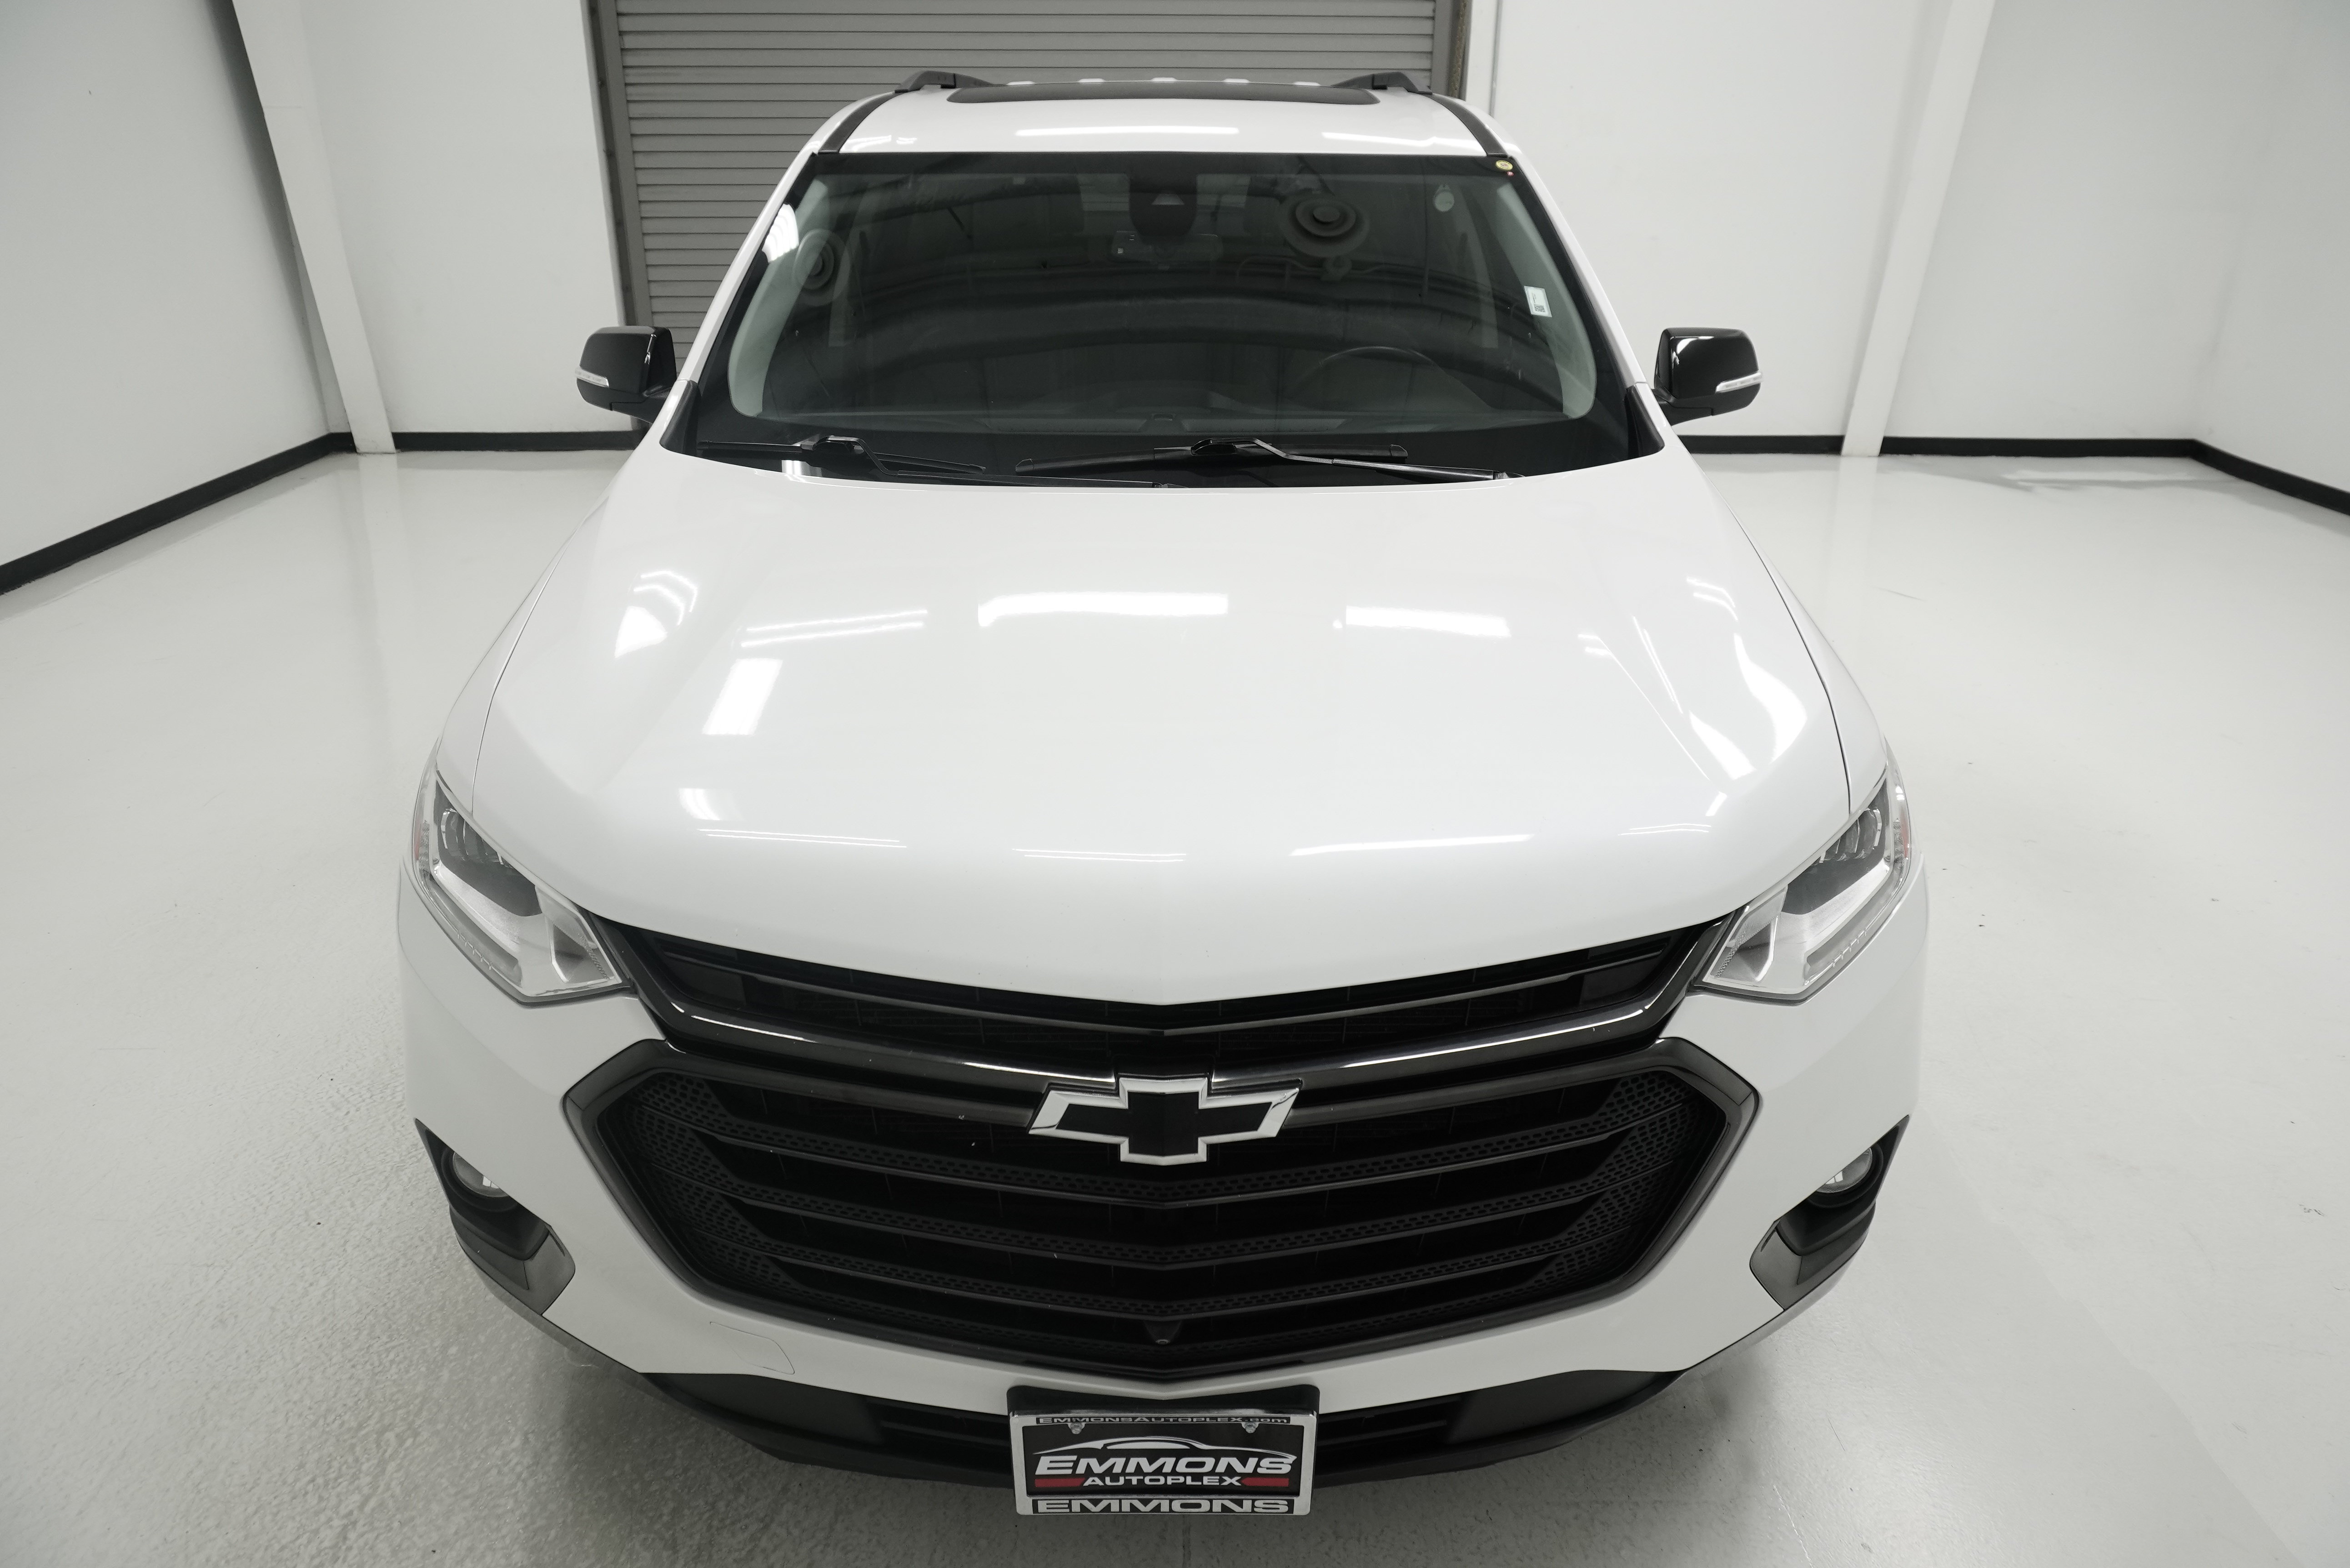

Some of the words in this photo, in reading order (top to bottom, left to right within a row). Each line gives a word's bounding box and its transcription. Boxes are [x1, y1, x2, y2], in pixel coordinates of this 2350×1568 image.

[1035, 1455, 1292, 1475] EMMONS
[1083, 1476, 1242, 1487] AUTOPLEX
[1037, 1499, 1289, 1513] EMMONS
